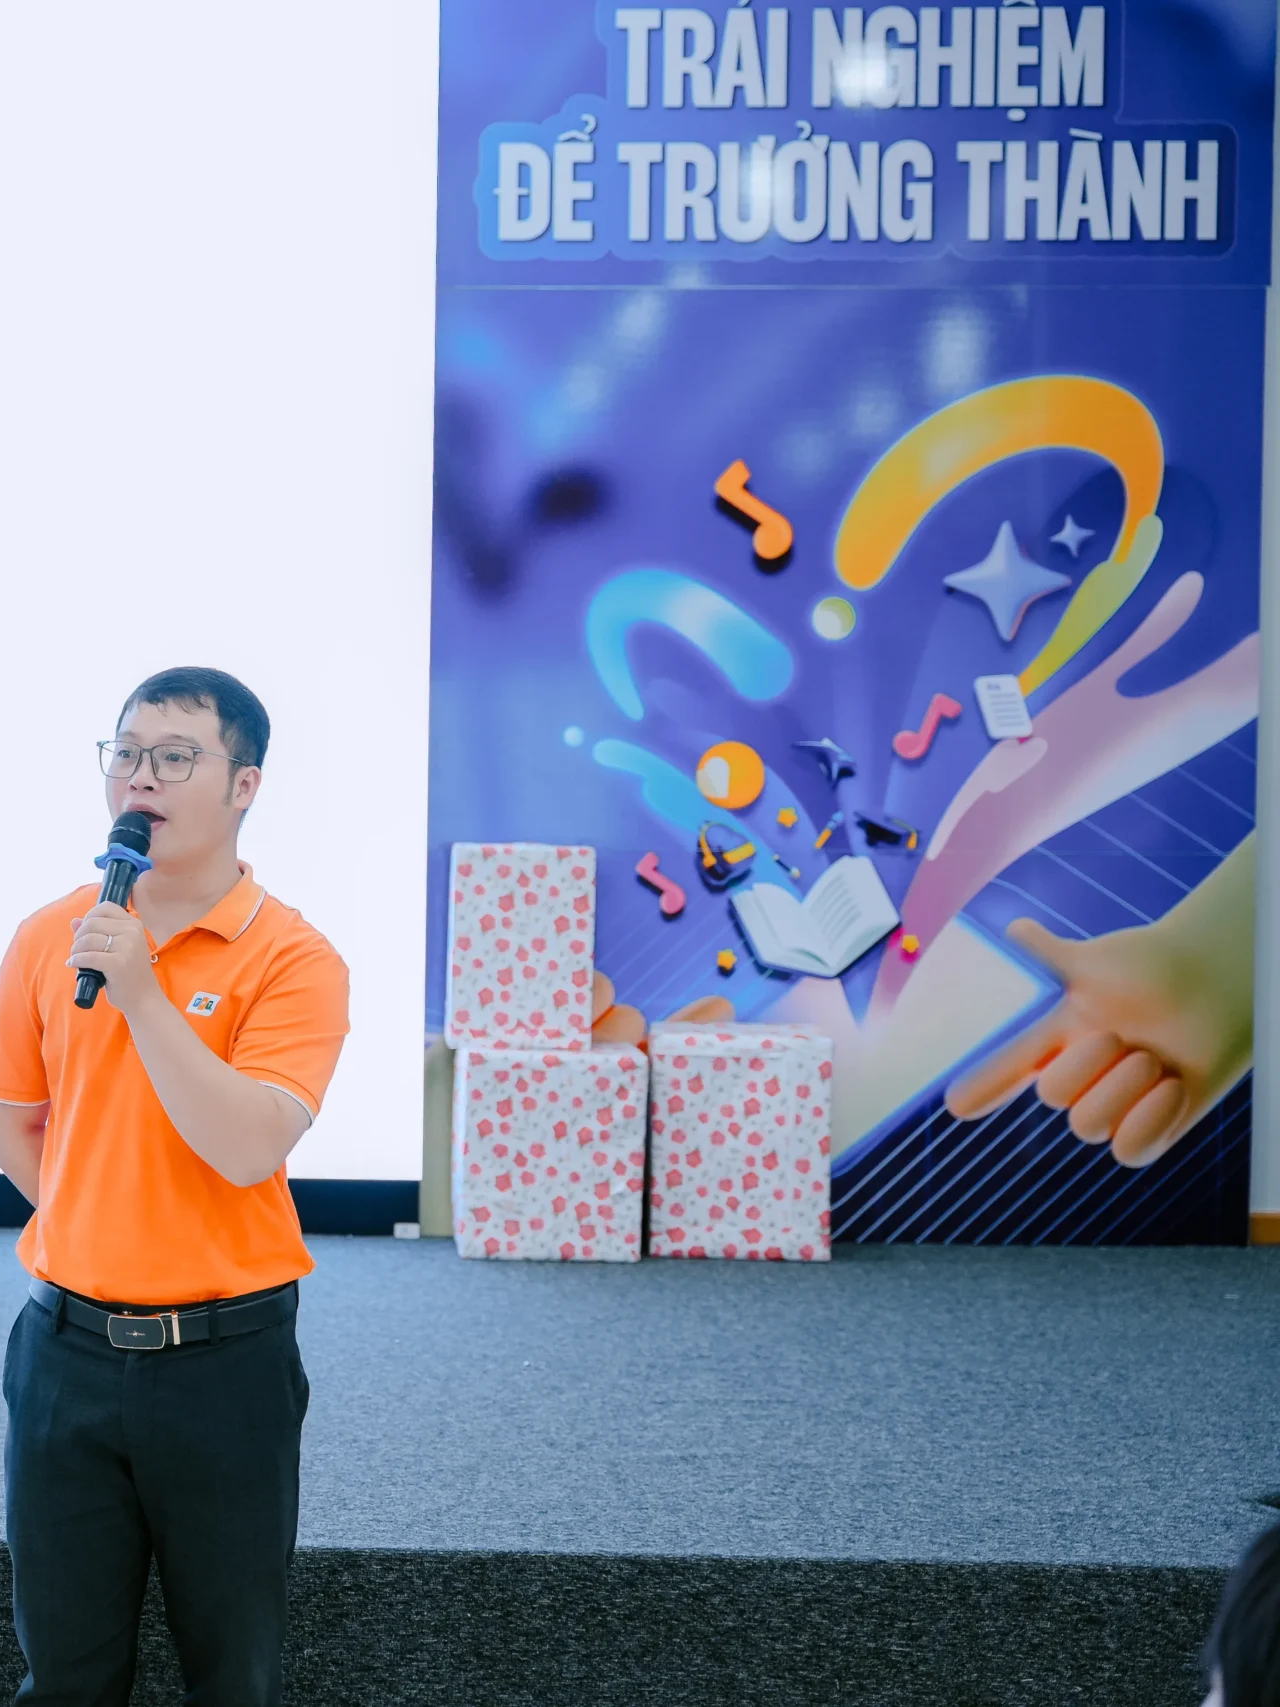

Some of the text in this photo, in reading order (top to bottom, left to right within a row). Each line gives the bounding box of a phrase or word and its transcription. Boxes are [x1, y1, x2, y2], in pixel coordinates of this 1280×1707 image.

[812, 0, 1105, 122] NGHIỆM
[492, 113, 1219, 243] ĐỂ TRƯỞNG THÀNH
